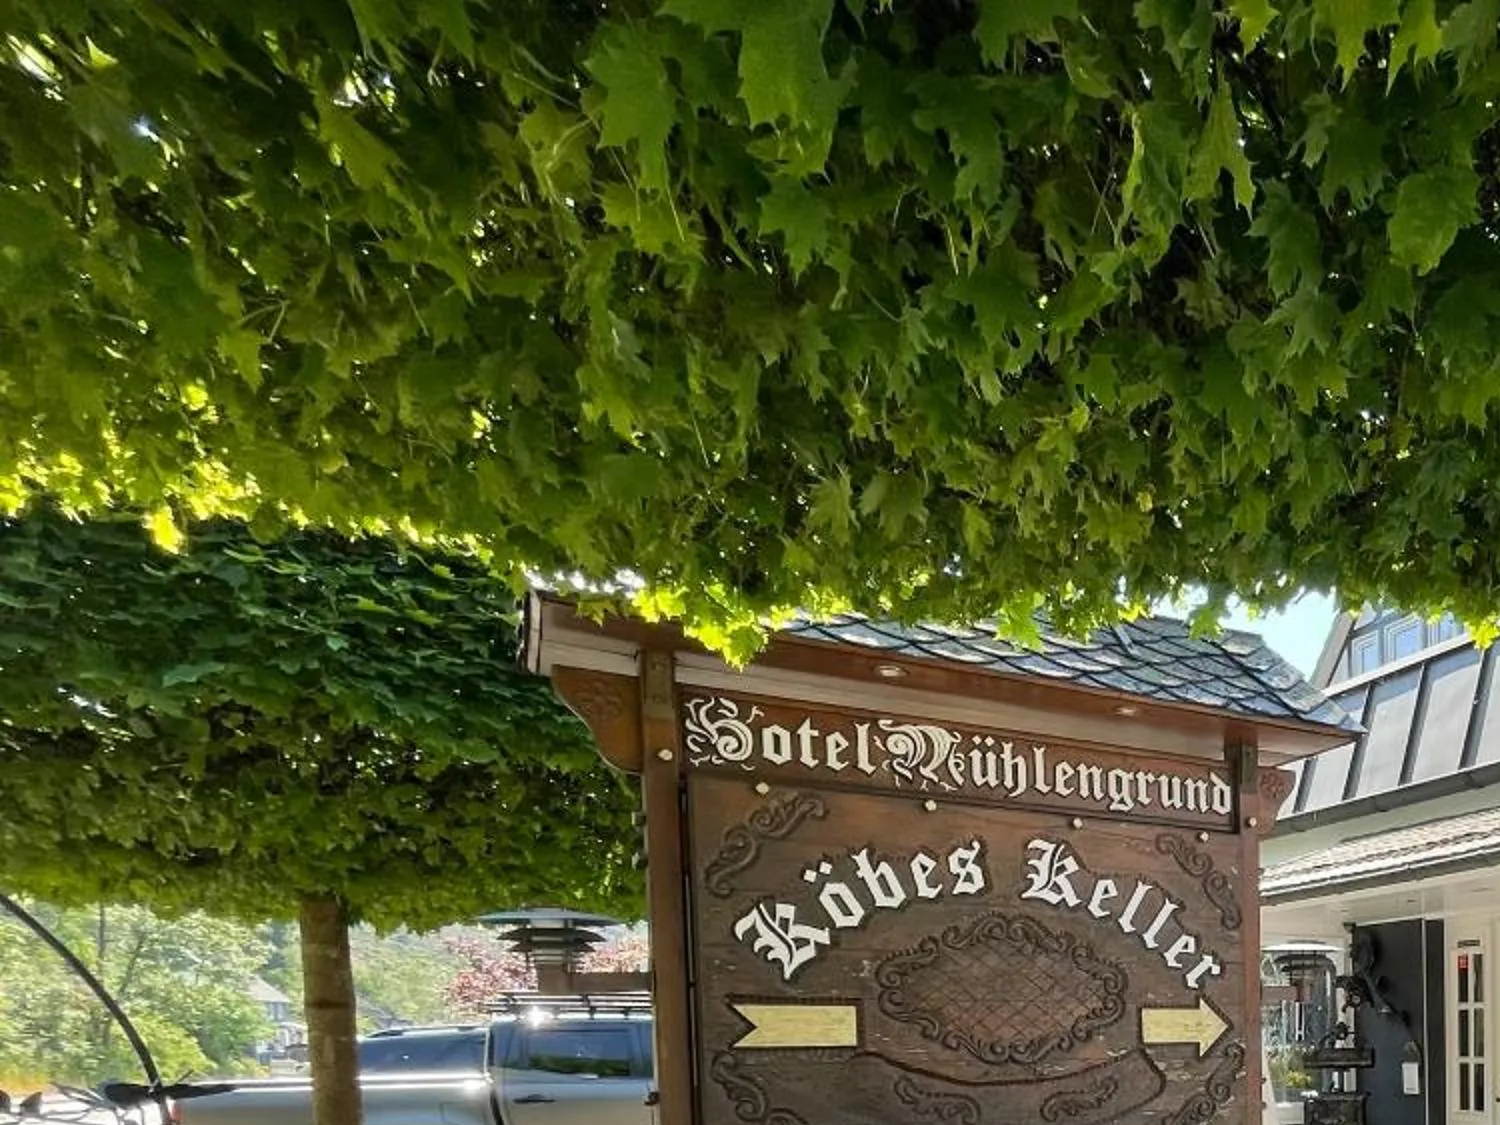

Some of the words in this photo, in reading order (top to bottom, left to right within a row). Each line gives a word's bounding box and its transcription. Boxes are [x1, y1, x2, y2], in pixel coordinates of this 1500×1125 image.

[685, 697, 878, 775] Hotel
[874, 719, 1232, 815] Mühlengrund
[734, 839, 986, 981] Köbes
[1021, 838, 1222, 989] Keller
